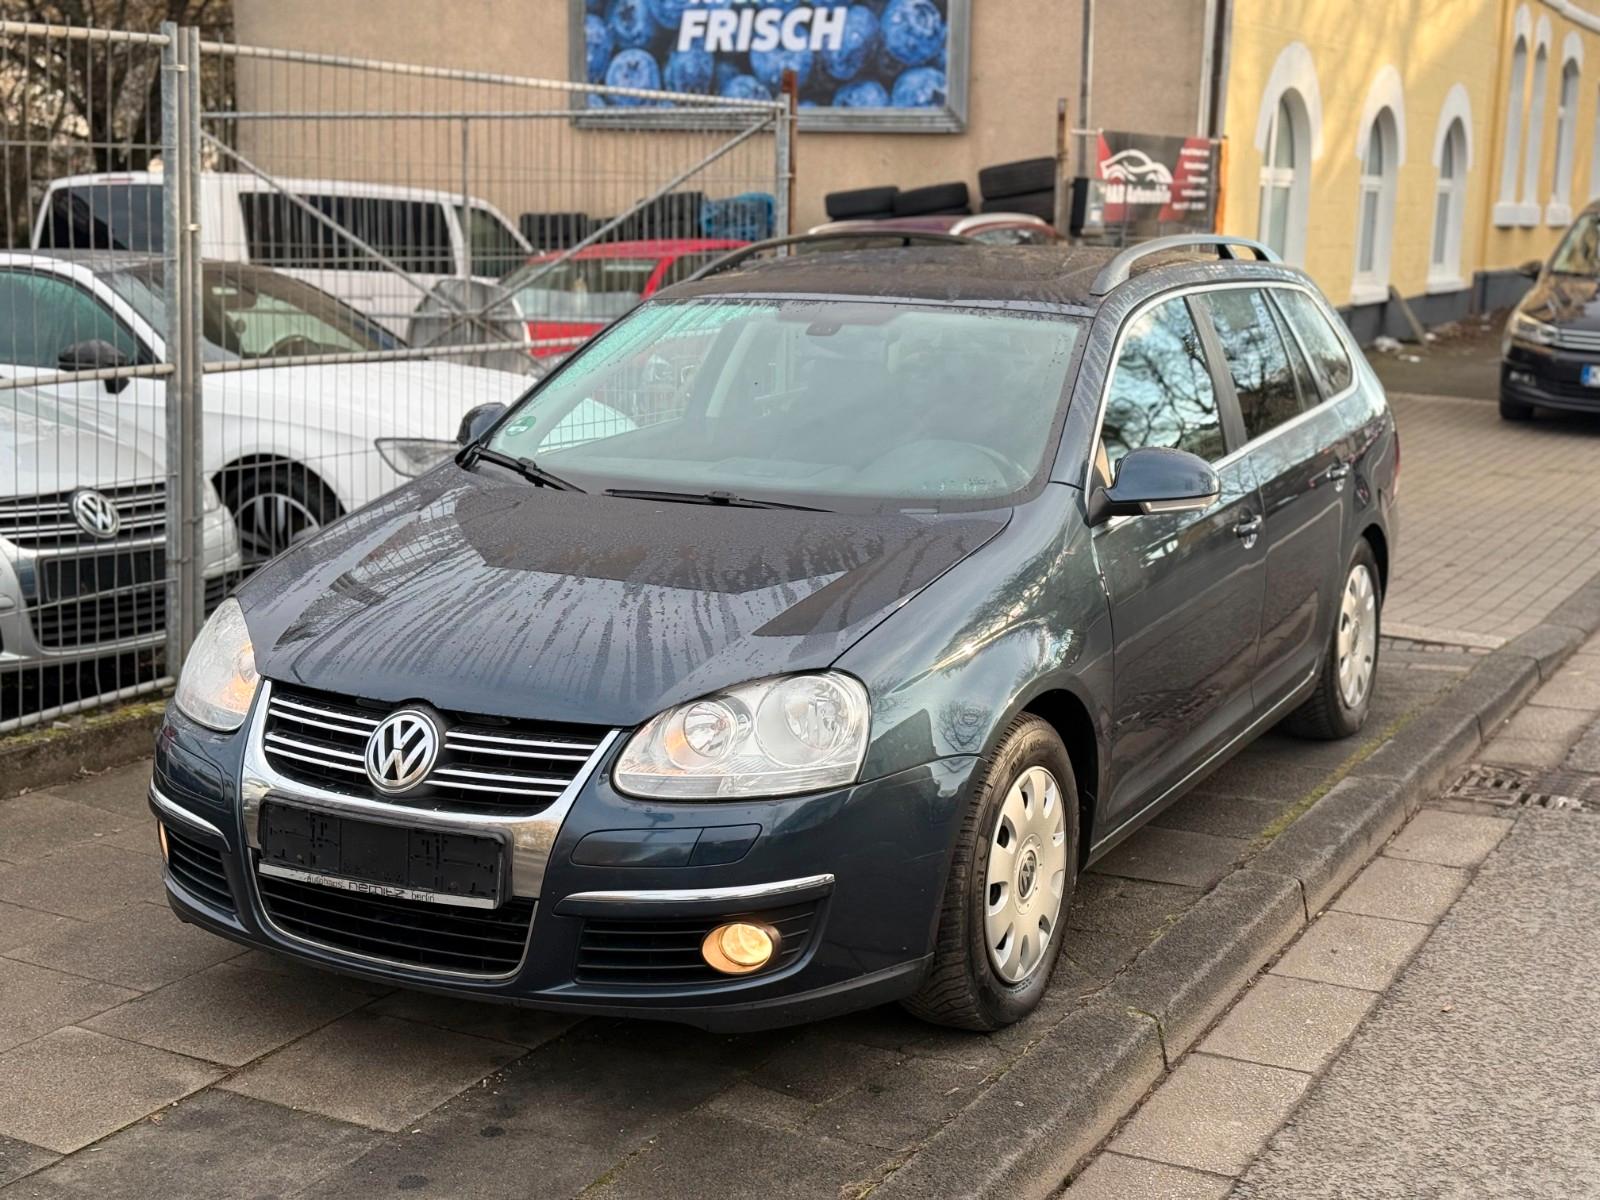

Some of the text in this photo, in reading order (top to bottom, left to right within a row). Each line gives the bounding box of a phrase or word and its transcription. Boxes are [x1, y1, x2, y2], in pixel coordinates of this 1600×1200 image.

[677, 7, 848, 52] FRISCH
[75, 492, 118, 535] VW
[367, 712, 437, 790] VW
